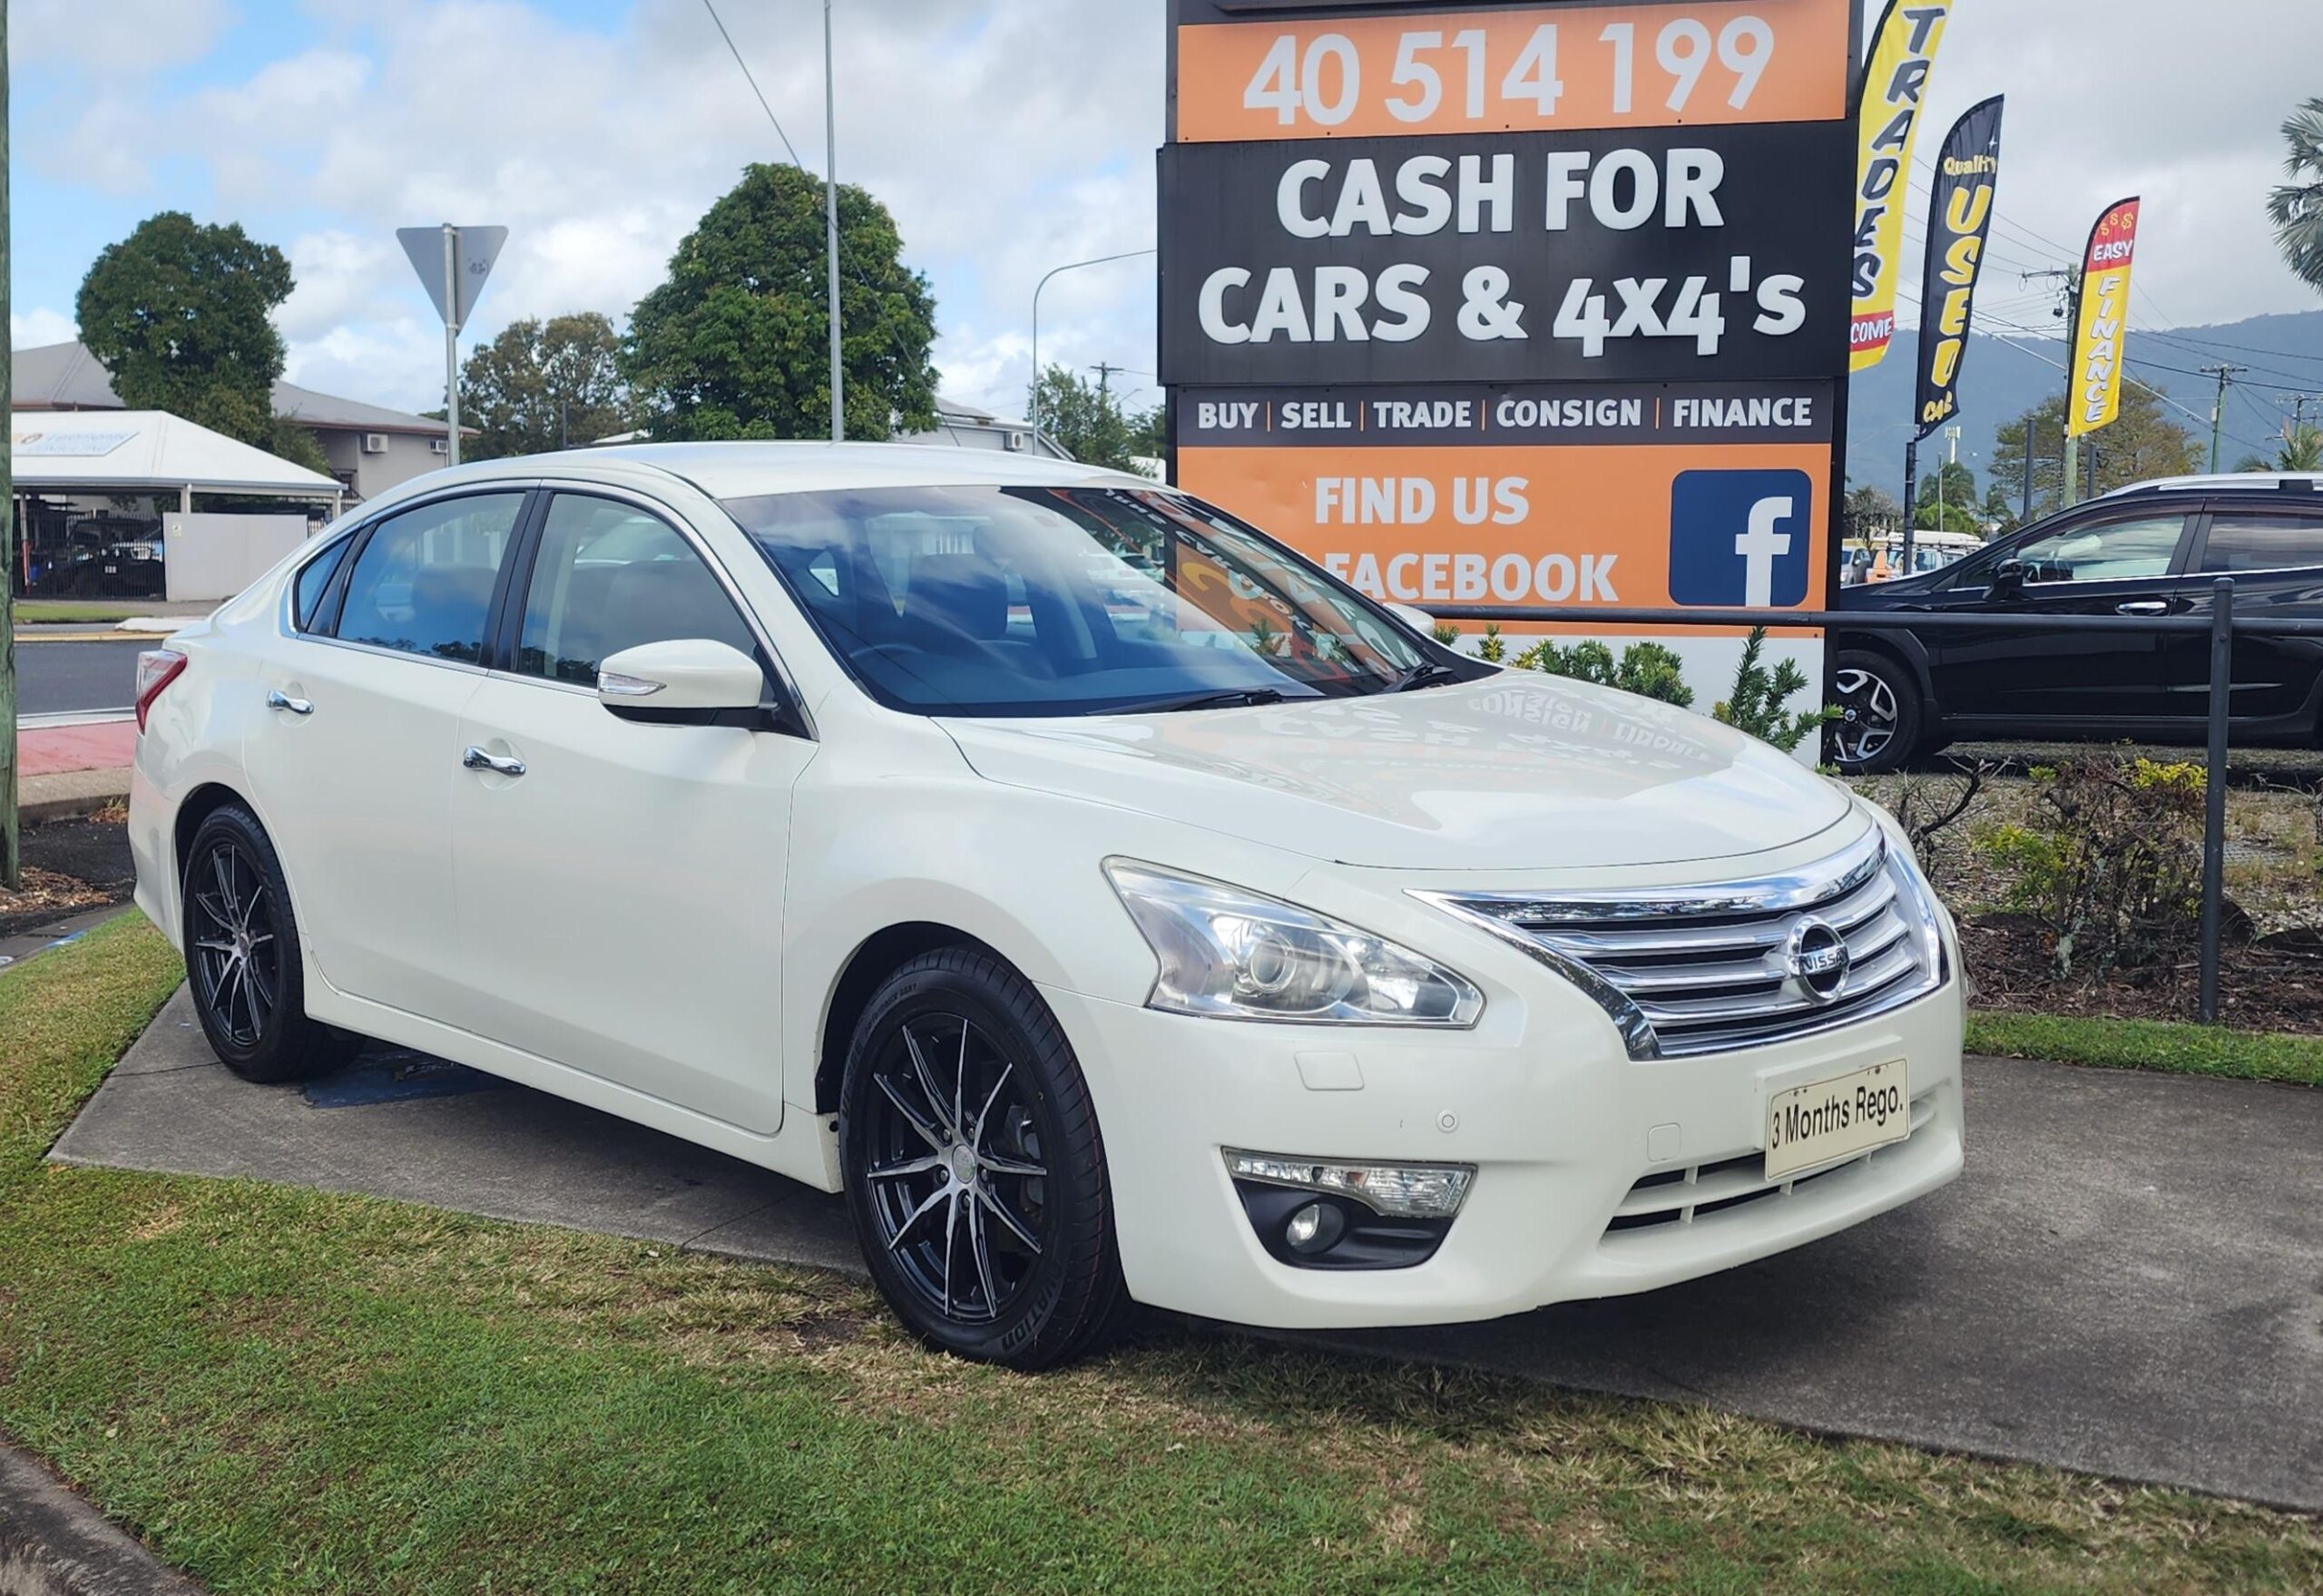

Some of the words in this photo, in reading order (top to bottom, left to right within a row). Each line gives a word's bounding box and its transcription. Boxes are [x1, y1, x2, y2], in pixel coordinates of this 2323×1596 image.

[1242, 33, 1361, 126] 40
[1385, 22, 1564, 123] 514
[1598, 14, 1776, 115] 199
[1852, 6, 1946, 298] TRADES
[1277, 153, 1514, 239] CASH
[1545, 148, 1724, 230] FOR
[1930, 184, 1993, 387] USED
[2093, 240, 2133, 261] EASY
[1198, 263, 1431, 344] CARS
[1456, 265, 1529, 341] &
[1850, 317, 1893, 344] COME
[2083, 275, 2120, 424] FINANCE
[1197, 401, 1259, 430] BUY
[1280, 401, 1353, 430] SELL
[1373, 400, 1472, 429] TRADE
[1495, 397, 1642, 428] CONSIGN
[1672, 397, 1813, 427] FINANCE
[1315, 476, 1436, 524] FIND
[1452, 475, 1529, 525] US
[1325, 553, 1618, 602] FACEBOOK
[1771, 1111, 1780, 1150] 3
[1785, 1094, 1849, 1145] Months
[1856, 1085, 1903, 1127] Rego.
